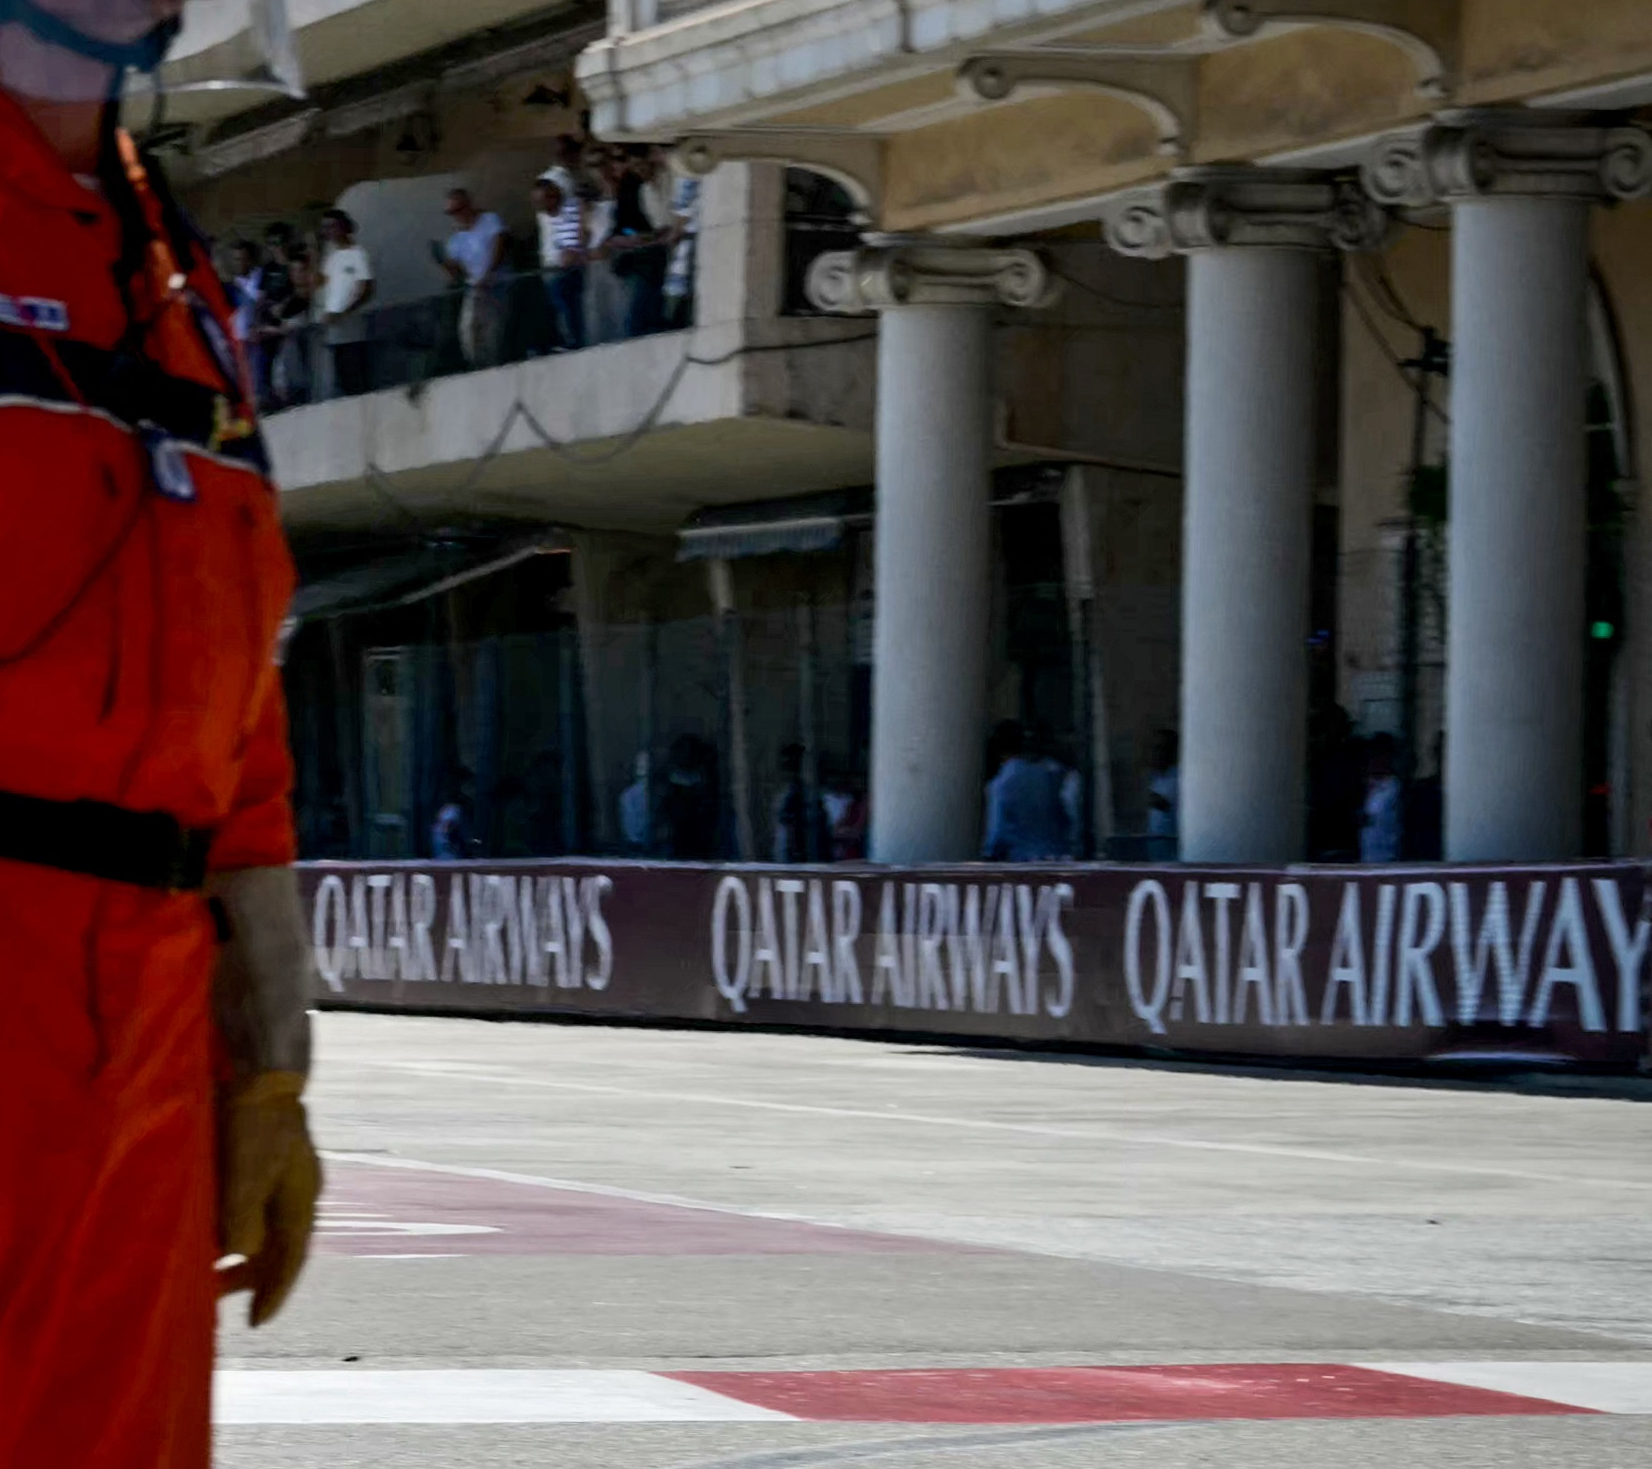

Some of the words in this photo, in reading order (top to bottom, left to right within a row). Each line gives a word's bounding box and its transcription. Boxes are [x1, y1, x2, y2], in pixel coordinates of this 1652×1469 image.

[313, 874, 437, 992] QATAR
[442, 873, 613, 991] AIRWAYS
[712, 876, 863, 1012] QATAR
[871, 881, 1075, 1018] AIRWAYS
[1123, 879, 1311, 1034] QATAR
